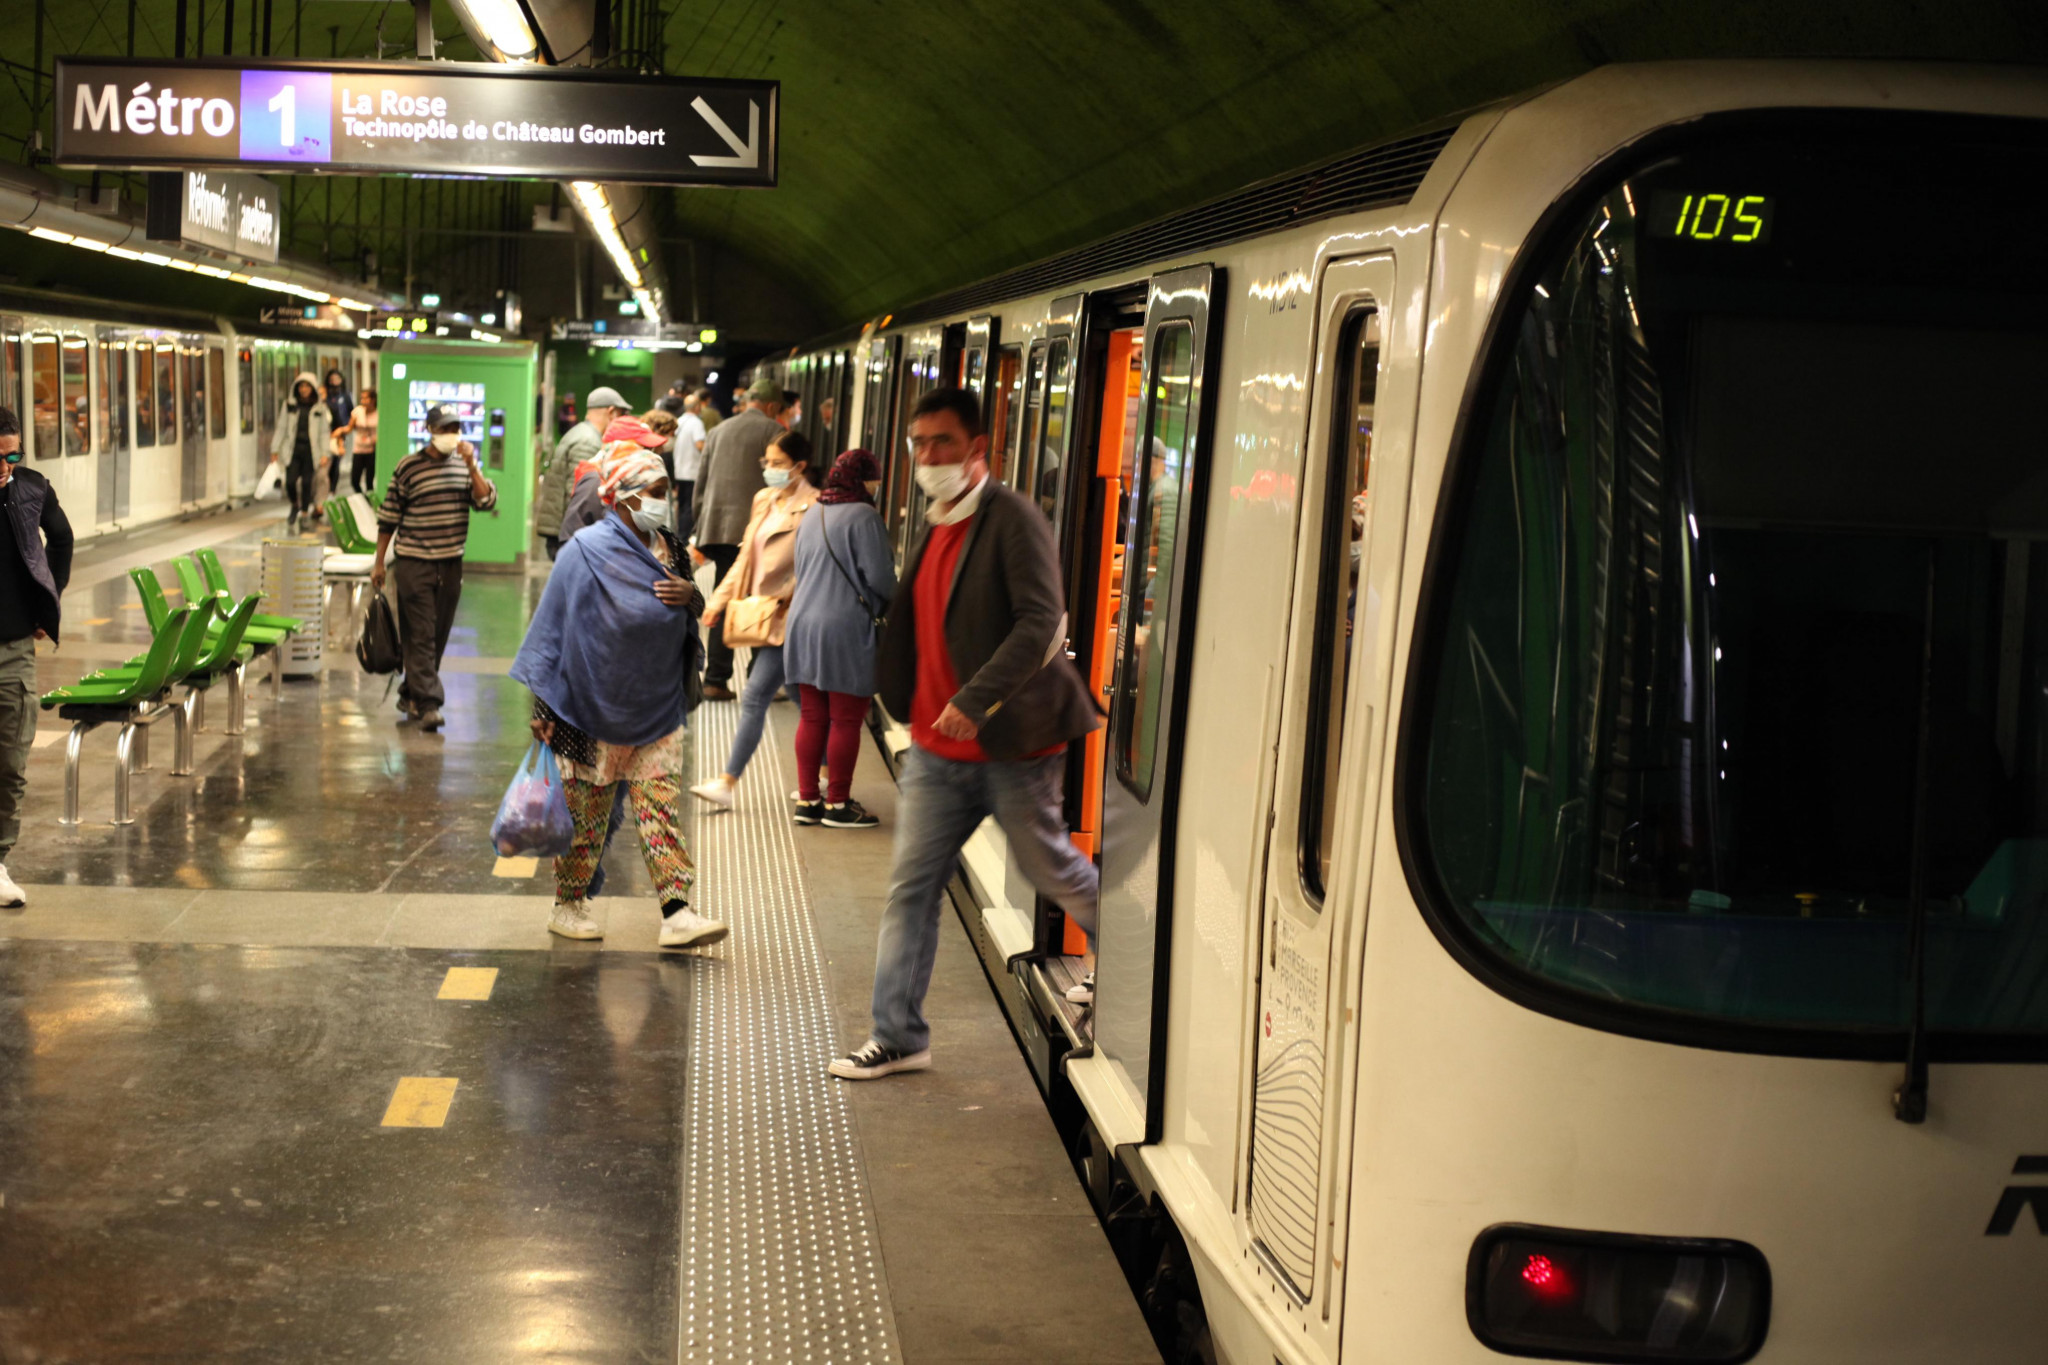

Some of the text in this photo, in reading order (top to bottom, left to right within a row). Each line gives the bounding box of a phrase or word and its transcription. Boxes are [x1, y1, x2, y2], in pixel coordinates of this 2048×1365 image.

[73, 81, 235, 138] Métro
[268, 85, 296, 147] 1
[342, 88, 447, 118] La Rose
[342, 117, 666, 146] Technopôle de Château Gombert
[1675, 193, 1765, 242] 105
[1280, 965, 1318, 1012] PROVENCE
[1281, 943, 1319, 989] MARSEILLE
